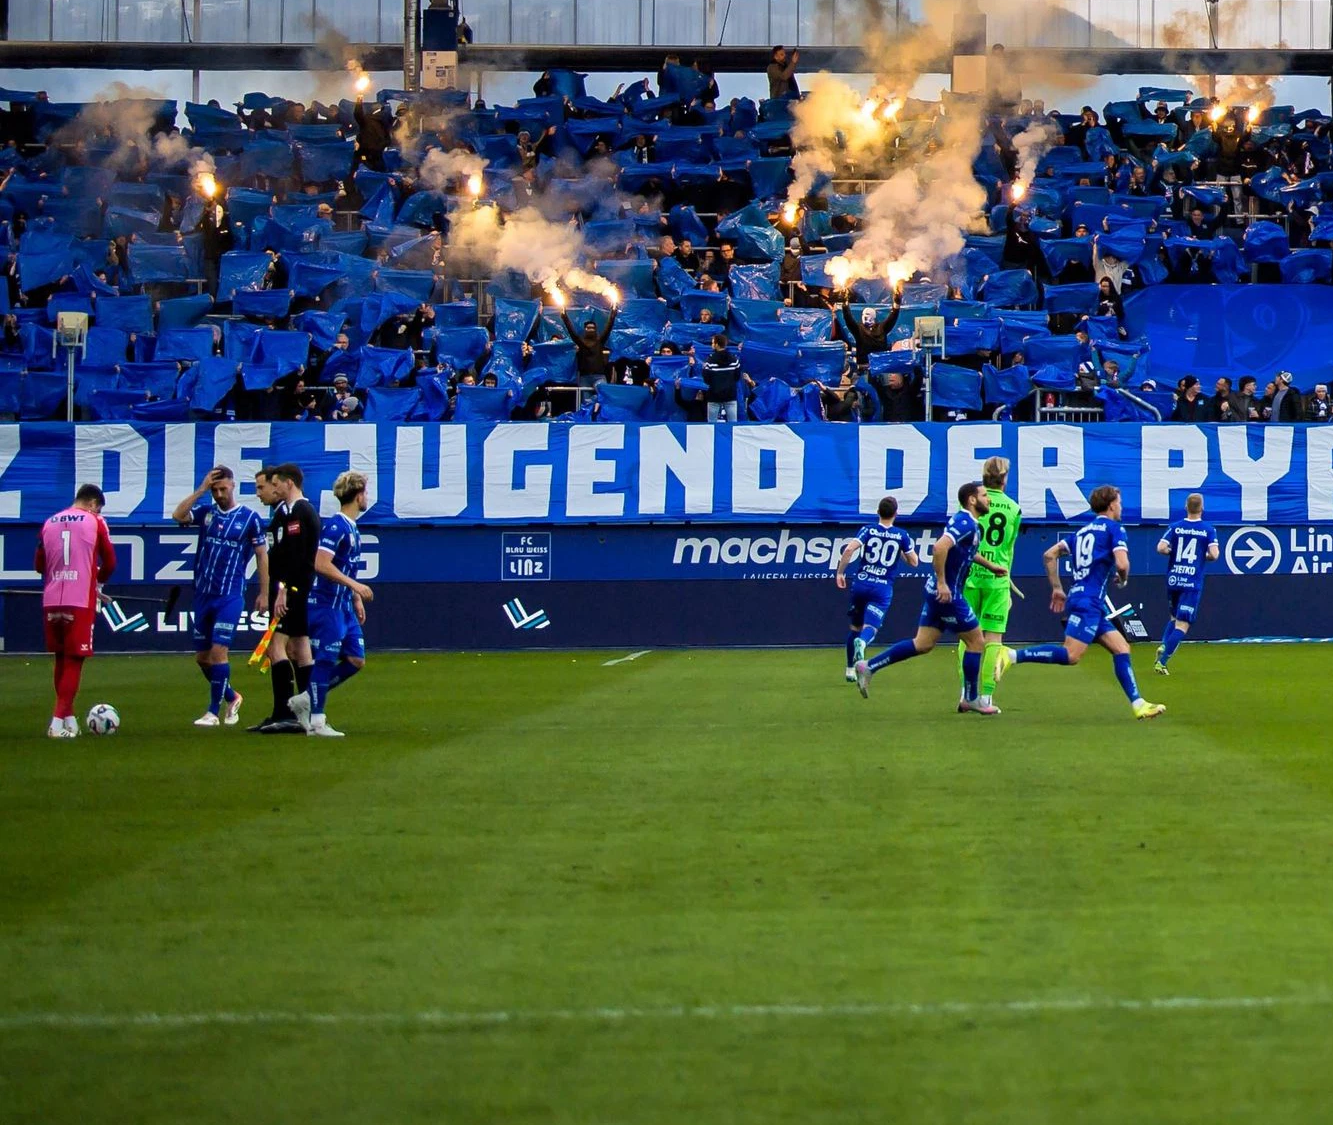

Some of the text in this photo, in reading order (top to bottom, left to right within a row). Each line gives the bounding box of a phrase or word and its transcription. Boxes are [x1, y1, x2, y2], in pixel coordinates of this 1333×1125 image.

[75, 423, 272, 519] DIE
[320, 423, 804, 519] JUGEND
[859, 424, 1089, 519] DER
[60, 515, 85, 523] BWT
[989, 501, 1011, 510] bank
[521, 537, 532, 545] FC
[869, 528, 902, 540] Oberbank
[1174, 527, 1208, 537] Oberbank
[61, 530, 71, 565] 1
[673, 529, 933, 570] machspt
[865, 537, 900, 567] 30
[1076, 532, 1095, 568] 19
[1176, 536, 1197, 564] 14
